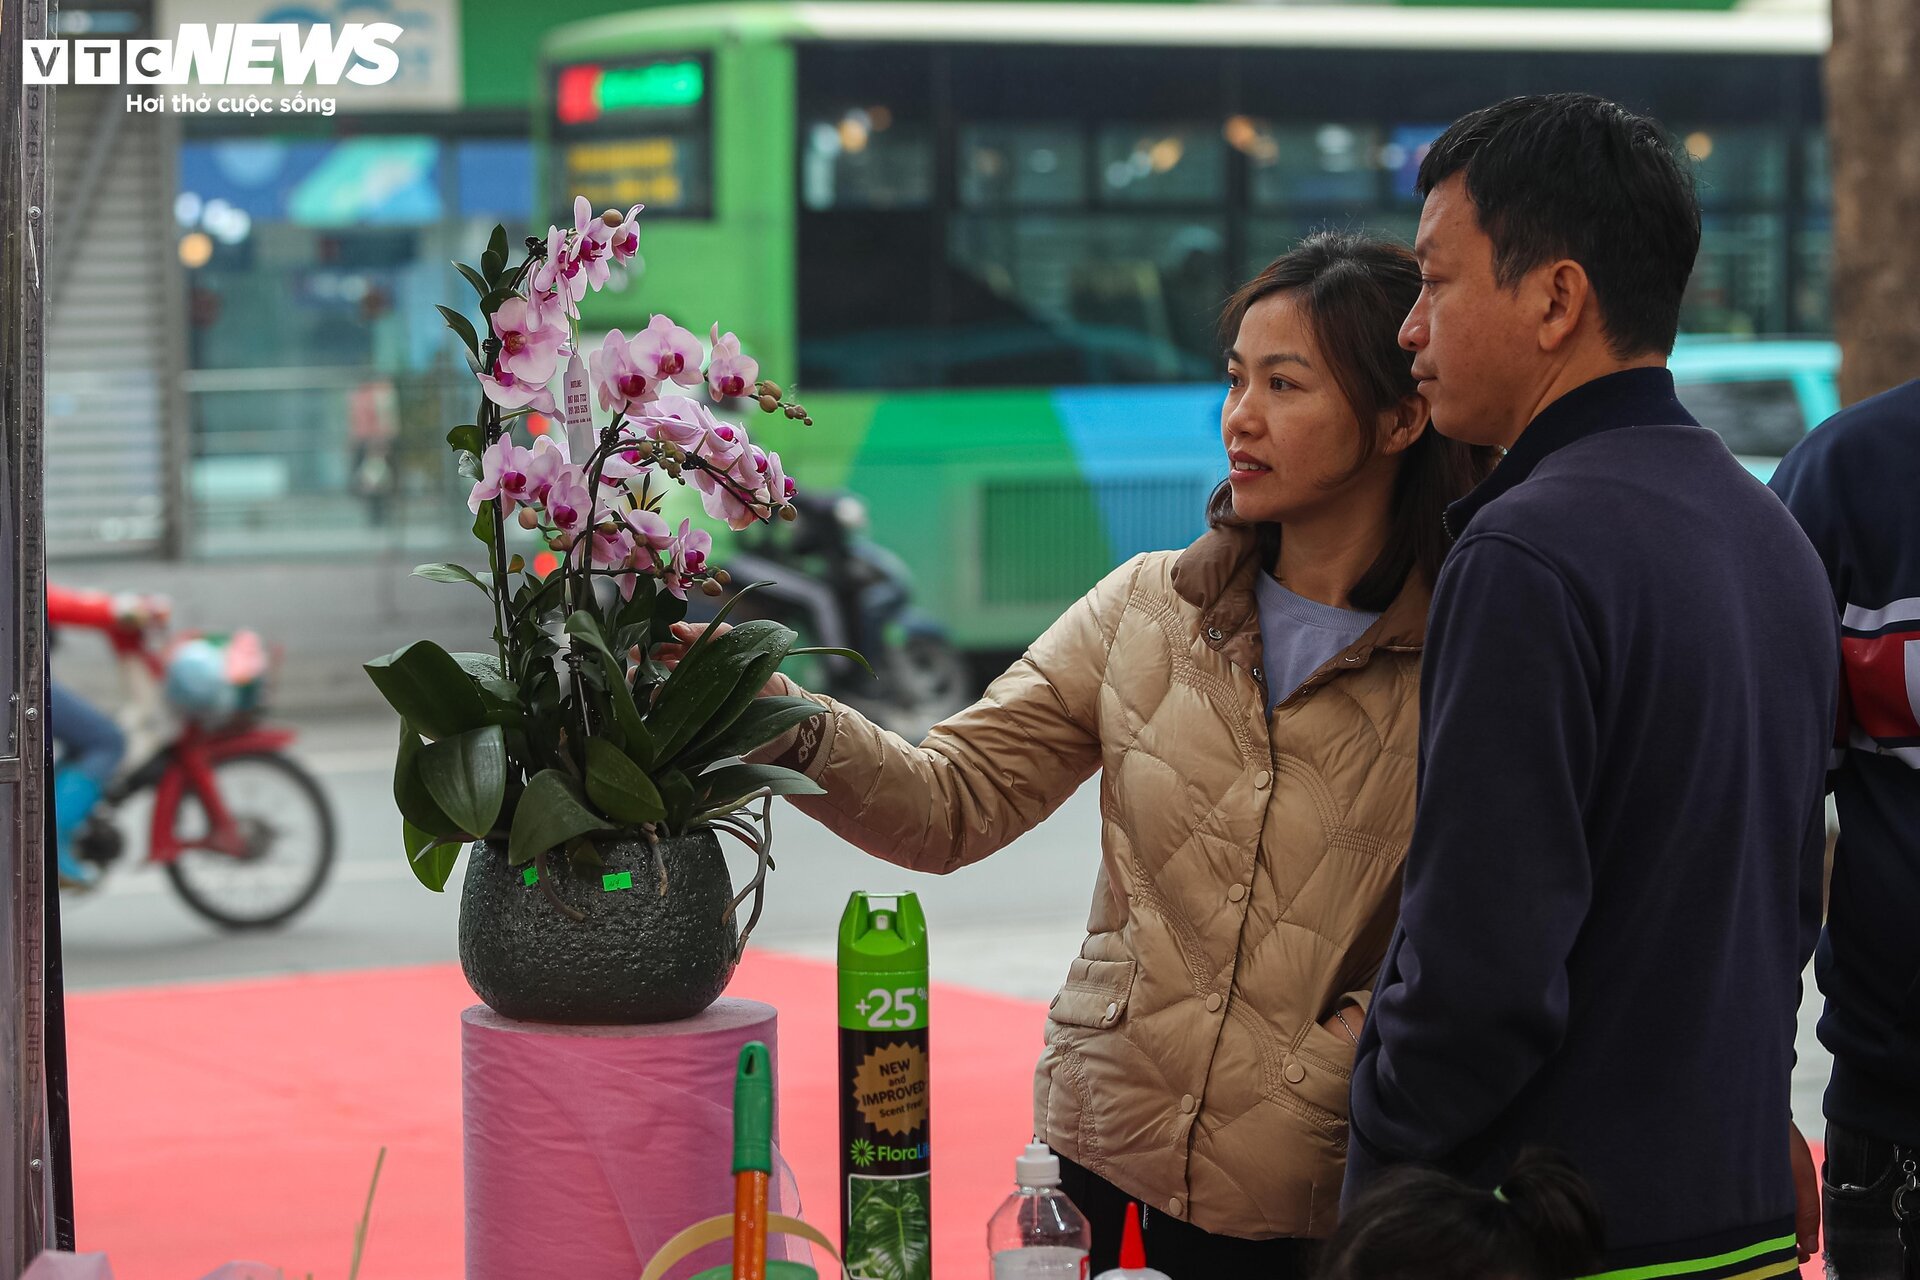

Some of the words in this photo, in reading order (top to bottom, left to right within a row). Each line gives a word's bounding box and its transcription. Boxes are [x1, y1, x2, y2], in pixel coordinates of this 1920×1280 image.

[879, 1058, 910, 1077] NEW
[888, 1074, 907, 1087] and
[862, 1080, 926, 1106] IMPROVED
[880, 1105, 905, 1118] Scent
